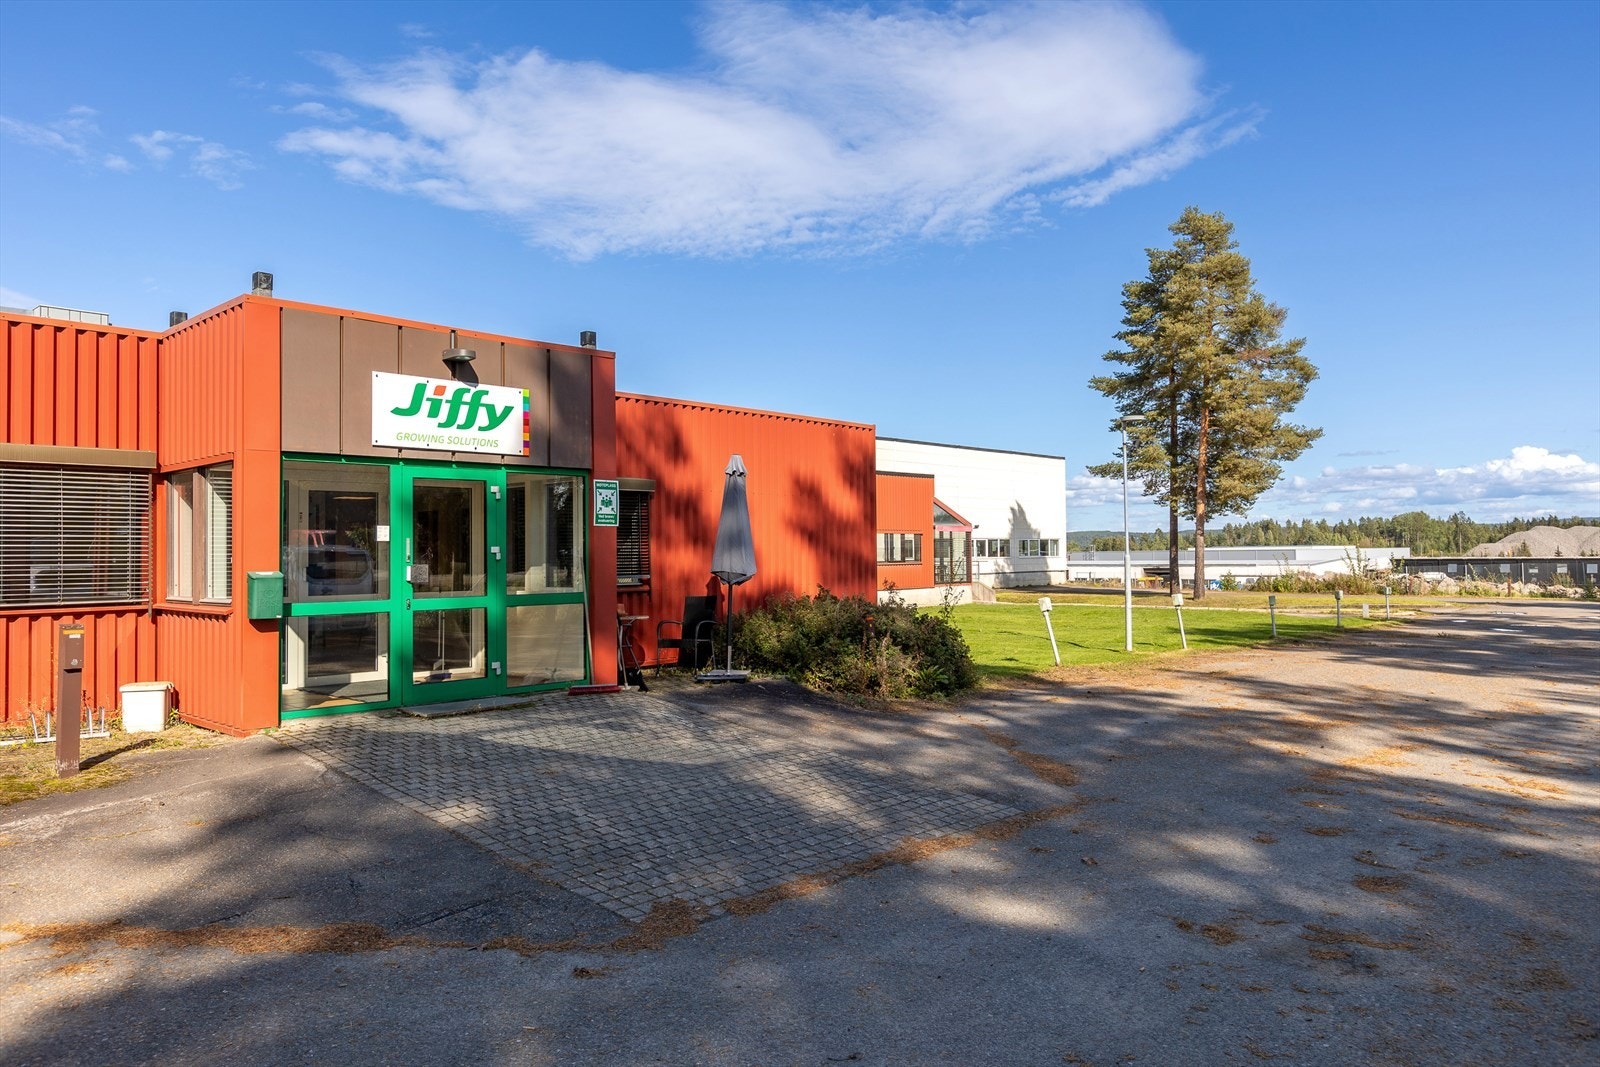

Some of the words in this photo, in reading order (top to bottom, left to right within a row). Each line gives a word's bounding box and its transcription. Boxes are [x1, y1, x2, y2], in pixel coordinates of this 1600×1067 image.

[390, 382, 515, 431] Jiffy
[396, 432, 445, 444] GROWING
[447, 436, 499, 448] SOLUTIONS
